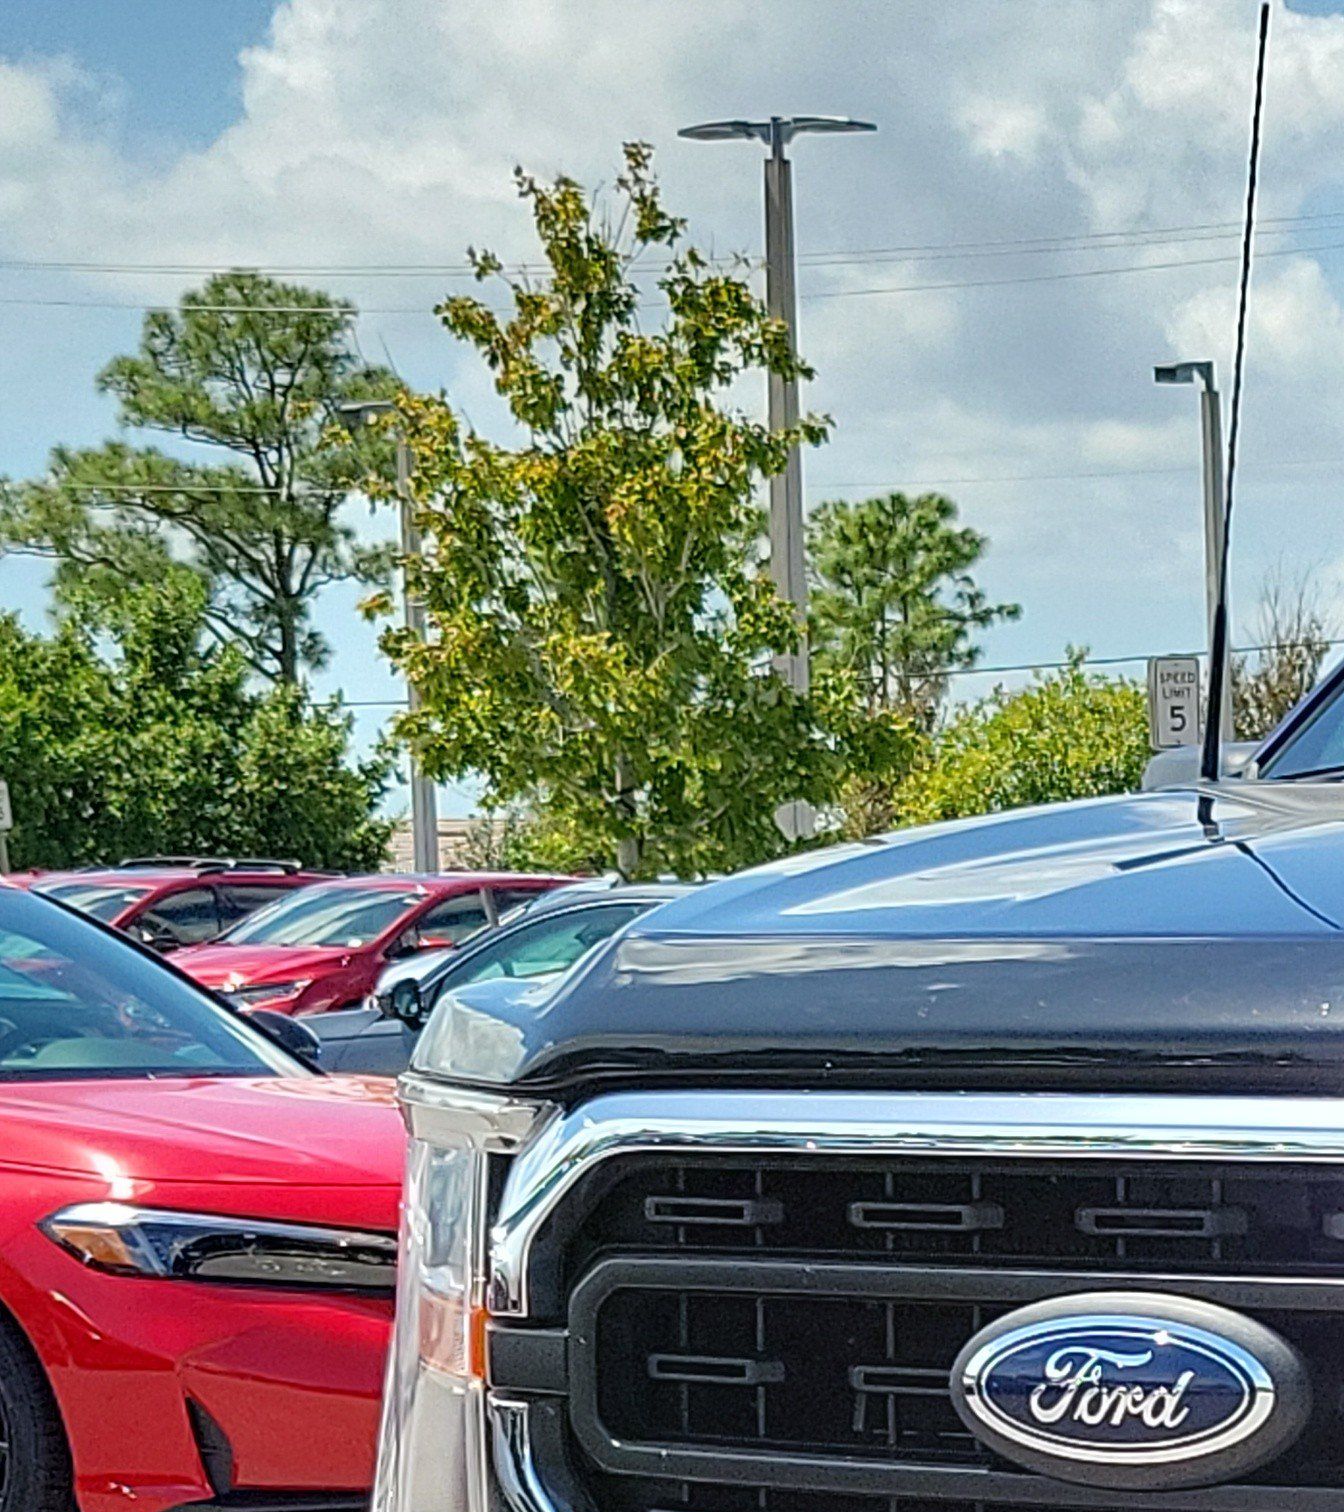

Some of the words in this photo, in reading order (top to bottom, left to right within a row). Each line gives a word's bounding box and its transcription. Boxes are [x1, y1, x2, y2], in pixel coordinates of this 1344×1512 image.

[1160, 672, 1195, 684] SPEED
[1162, 687, 1191, 699] LIMIT
[1169, 705, 1187, 732] 5
[1028, 1346, 1196, 1430] Ford
